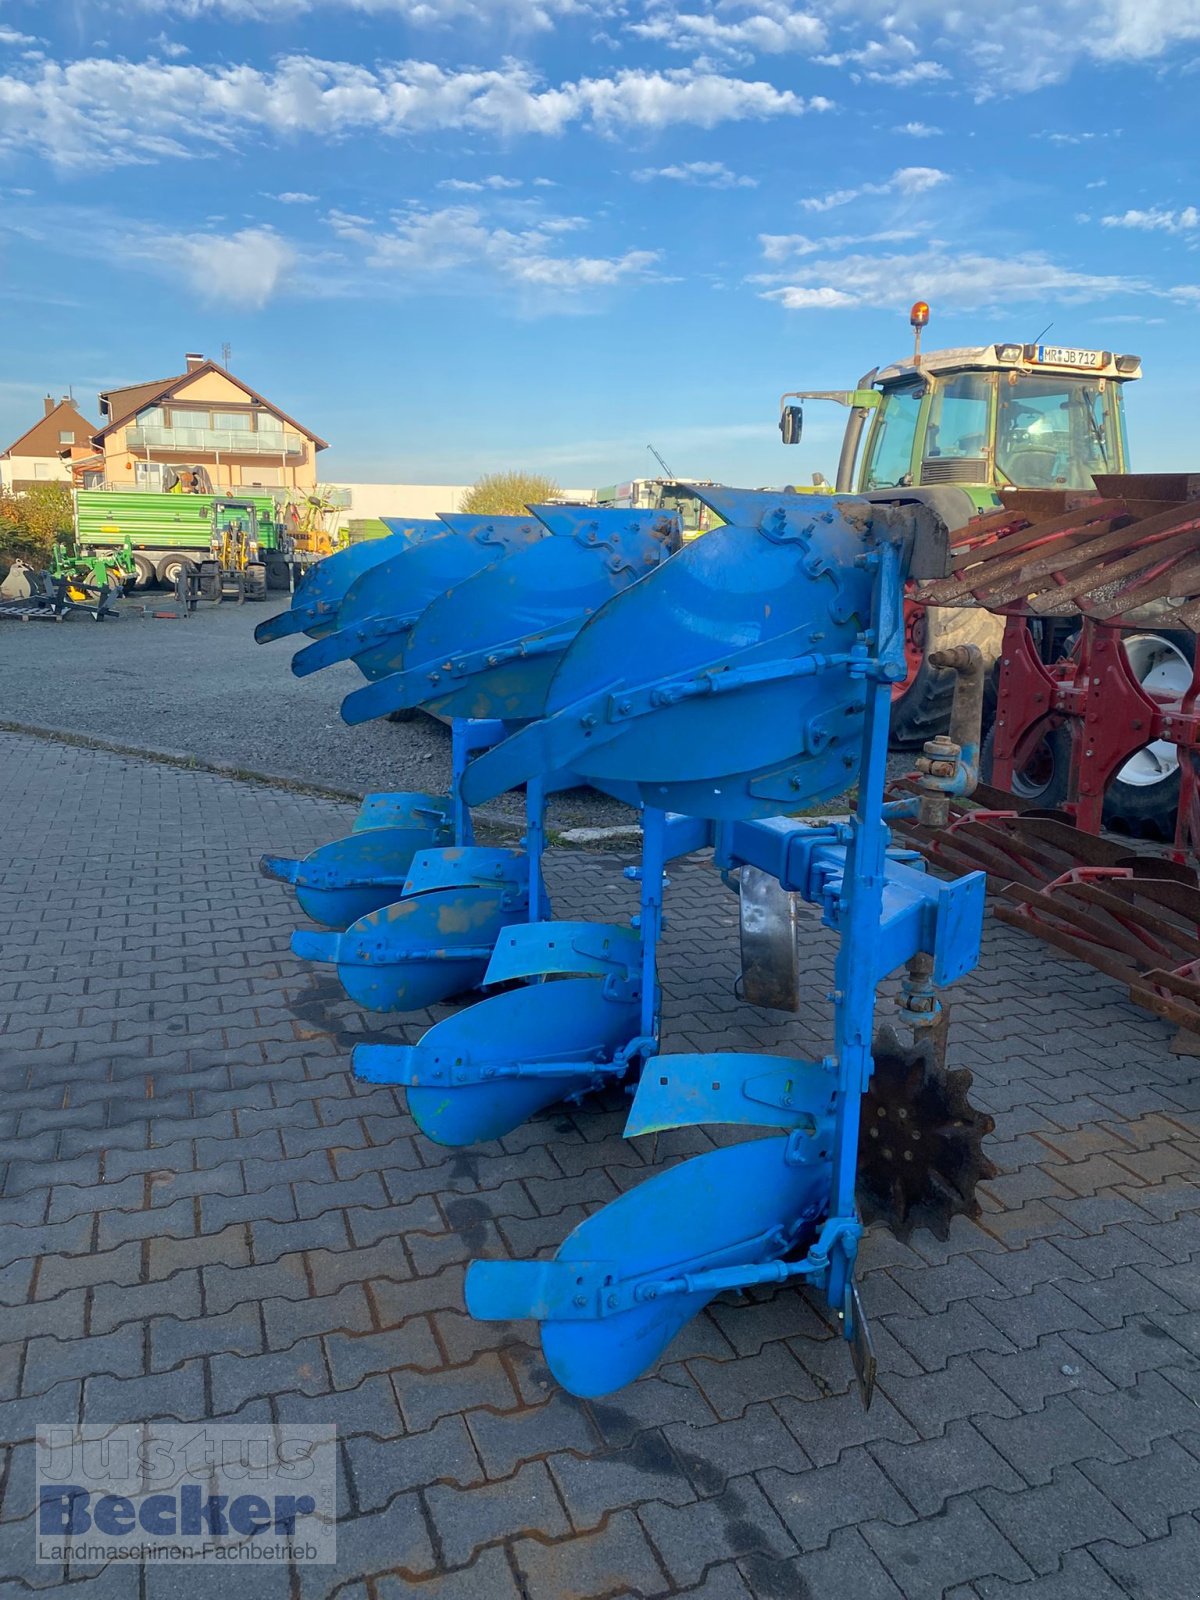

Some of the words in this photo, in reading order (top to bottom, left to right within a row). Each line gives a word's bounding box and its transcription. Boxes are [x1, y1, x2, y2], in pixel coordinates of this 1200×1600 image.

[1045, 349, 1057, 361] MR
[1064, 351, 1076, 363] JB
[1078, 353, 1095, 365] 712
